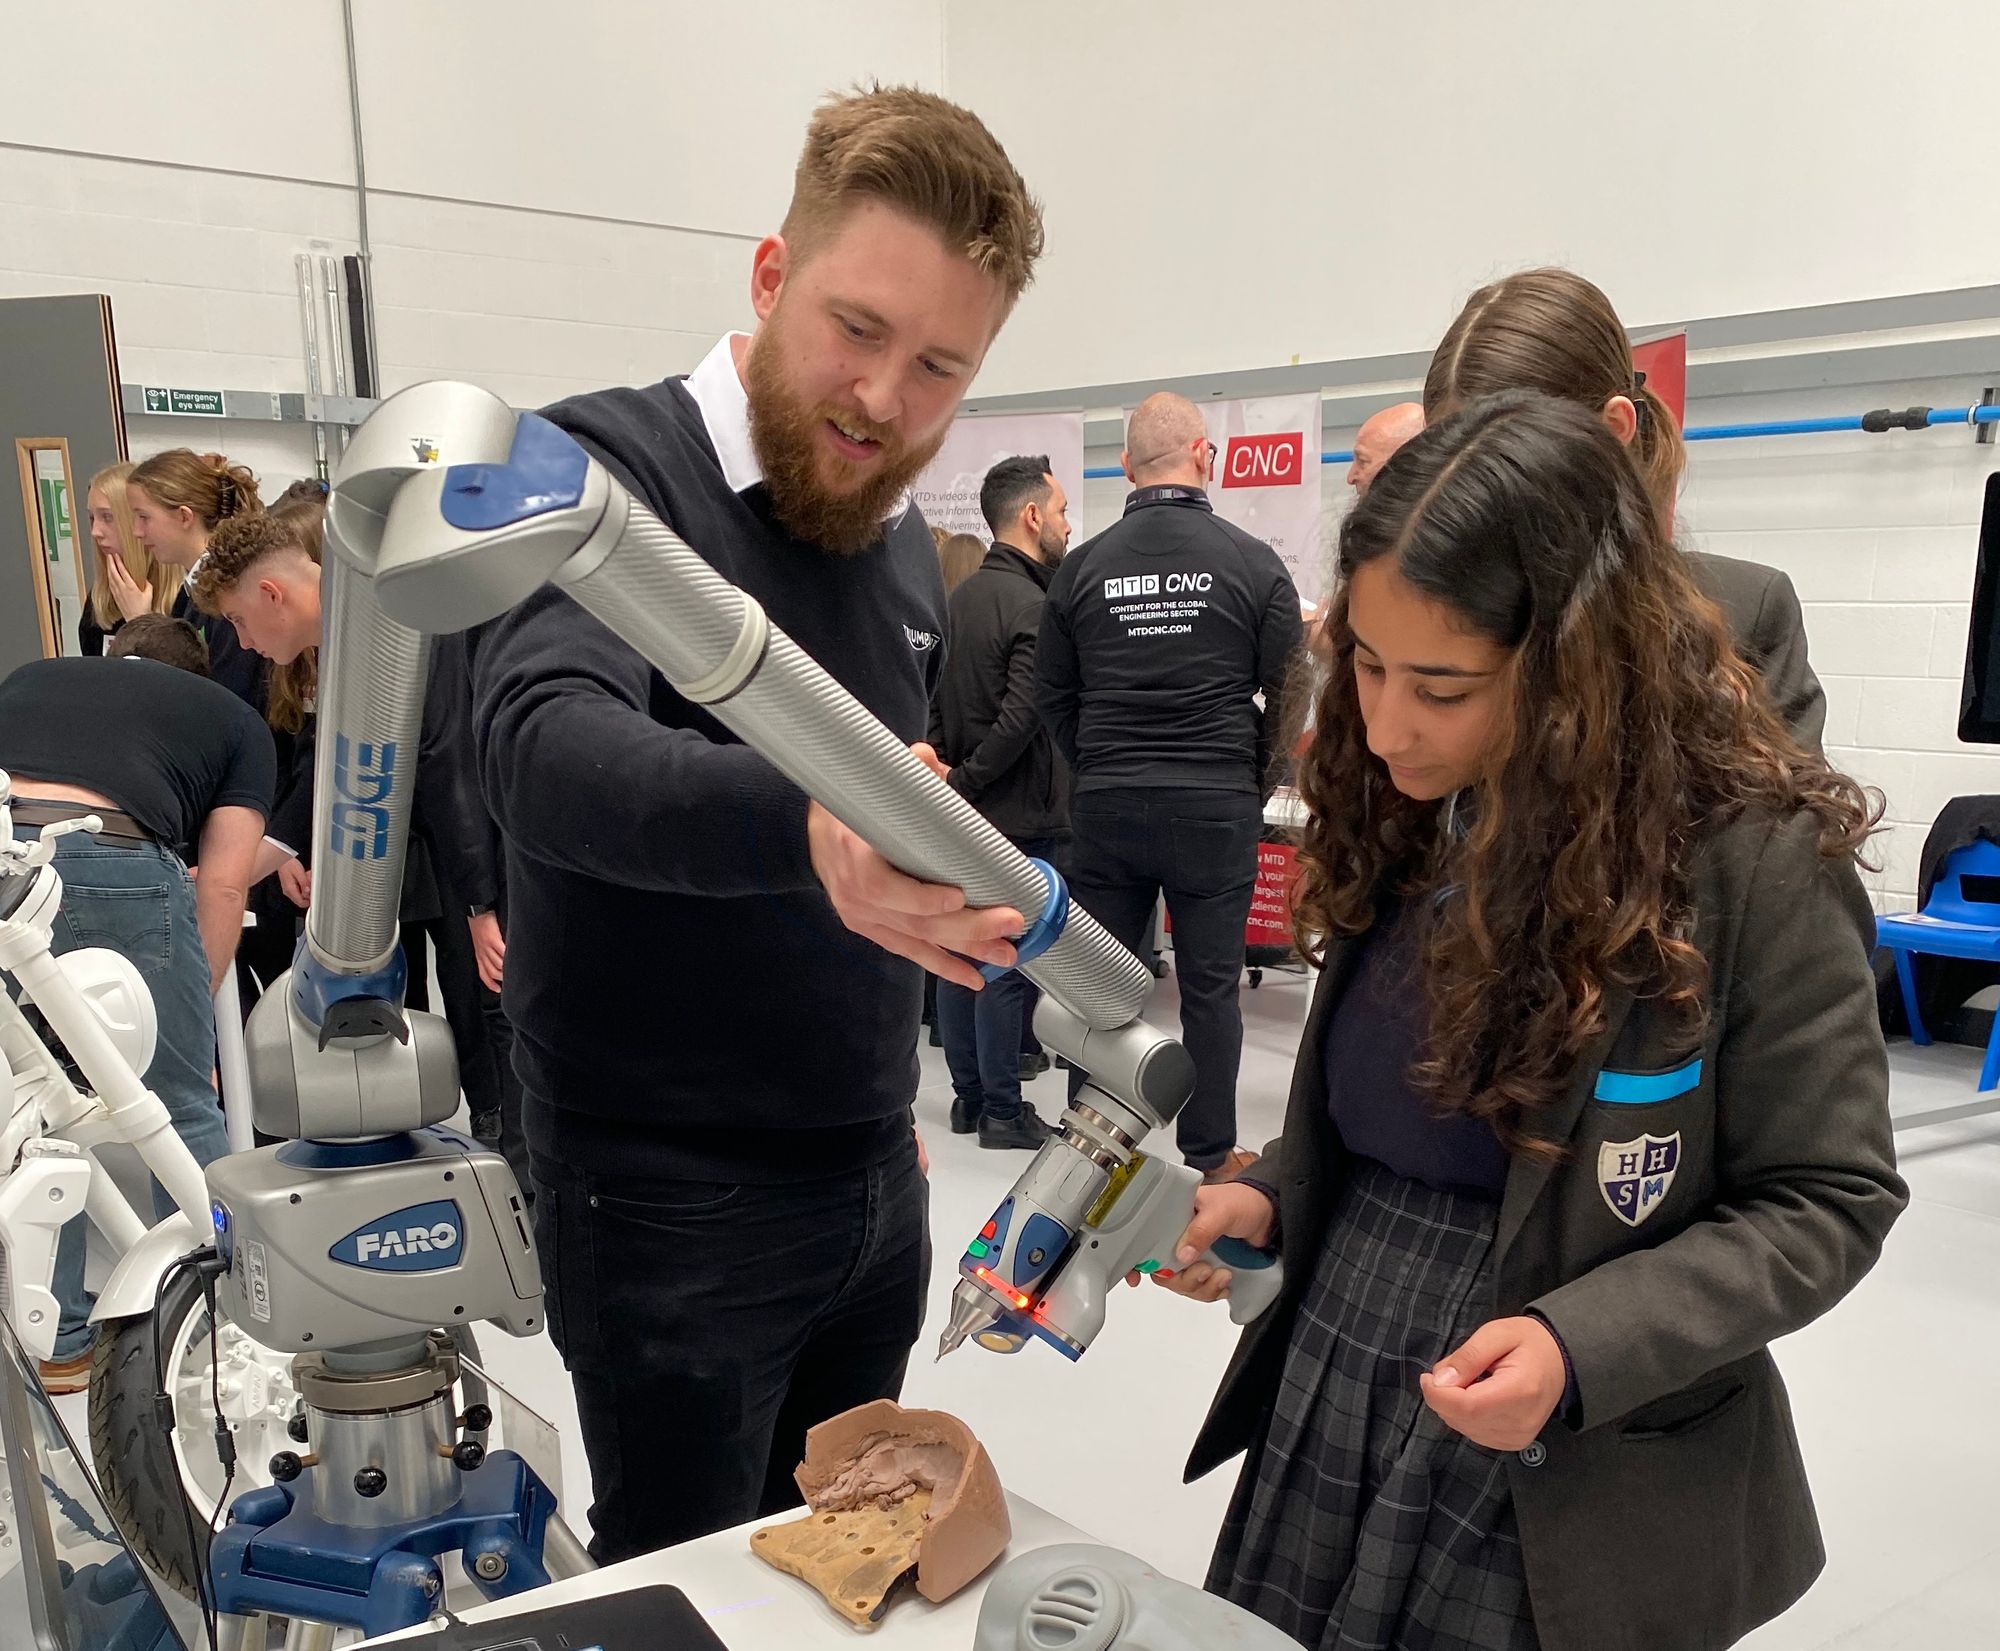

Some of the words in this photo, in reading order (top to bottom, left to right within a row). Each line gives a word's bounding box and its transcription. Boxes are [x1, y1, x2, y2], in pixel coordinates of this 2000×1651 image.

[173, 392, 218, 403] Emergency
[179, 402, 193, 410] eye
[1232, 443, 1293, 478] CNC
[939, 490, 968, 501] videos
[938, 520, 981, 532] Delivering
[1106, 576, 1158, 597] MTD
[1166, 572, 1213, 593] CNC
[1110, 604, 1145, 614] CONTENT
[1145, 602, 1161, 611] FOR
[1162, 602, 1177, 610] THE
[1178, 600, 1209, 609] GLOBAL
[1119, 611, 1169, 622] ENGINEERING
[1170, 609, 1199, 618] SECTOR
[1127, 624, 1192, 637] MTDCNC.COM
[331, 731, 396, 860] EDGE
[1264, 853, 1285, 866] MTD
[1265, 871, 1284, 882] your
[1254, 884, 1285, 898] largest
[356, 1222, 457, 1263] FARO
